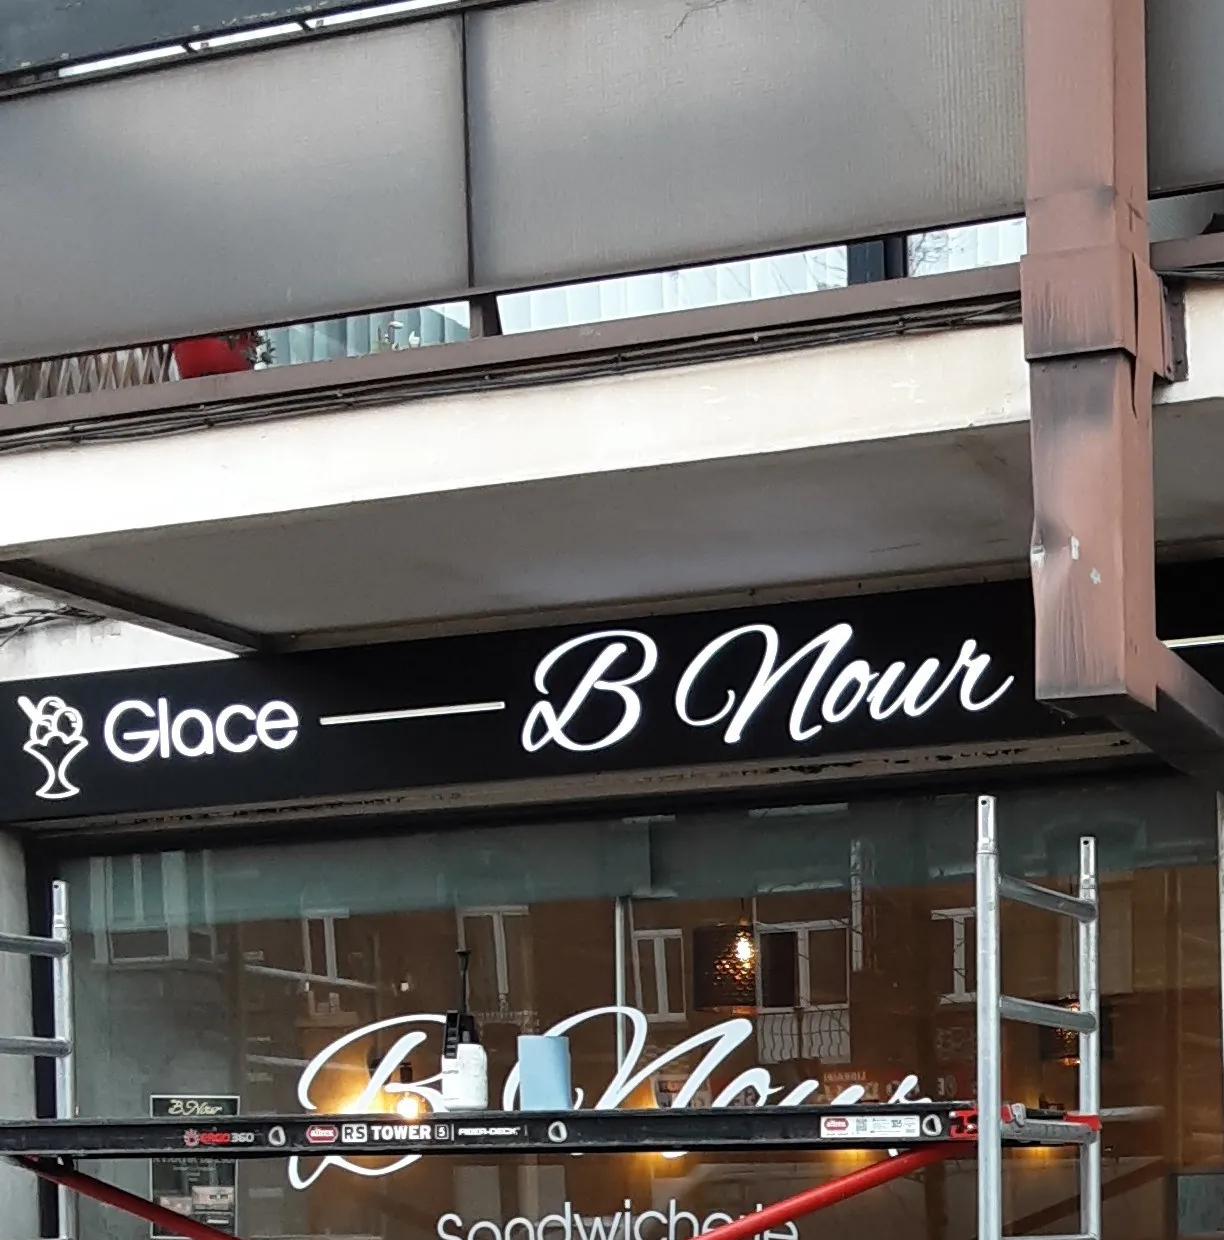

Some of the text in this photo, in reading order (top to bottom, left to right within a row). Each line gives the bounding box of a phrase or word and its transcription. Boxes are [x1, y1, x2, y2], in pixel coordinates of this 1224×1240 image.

[521, 623, 1015, 752] B Nour
[103, 697, 299, 763] Glace
[344, 1126, 366, 1140] RS
[371, 1125, 431, 1140] TOWER
